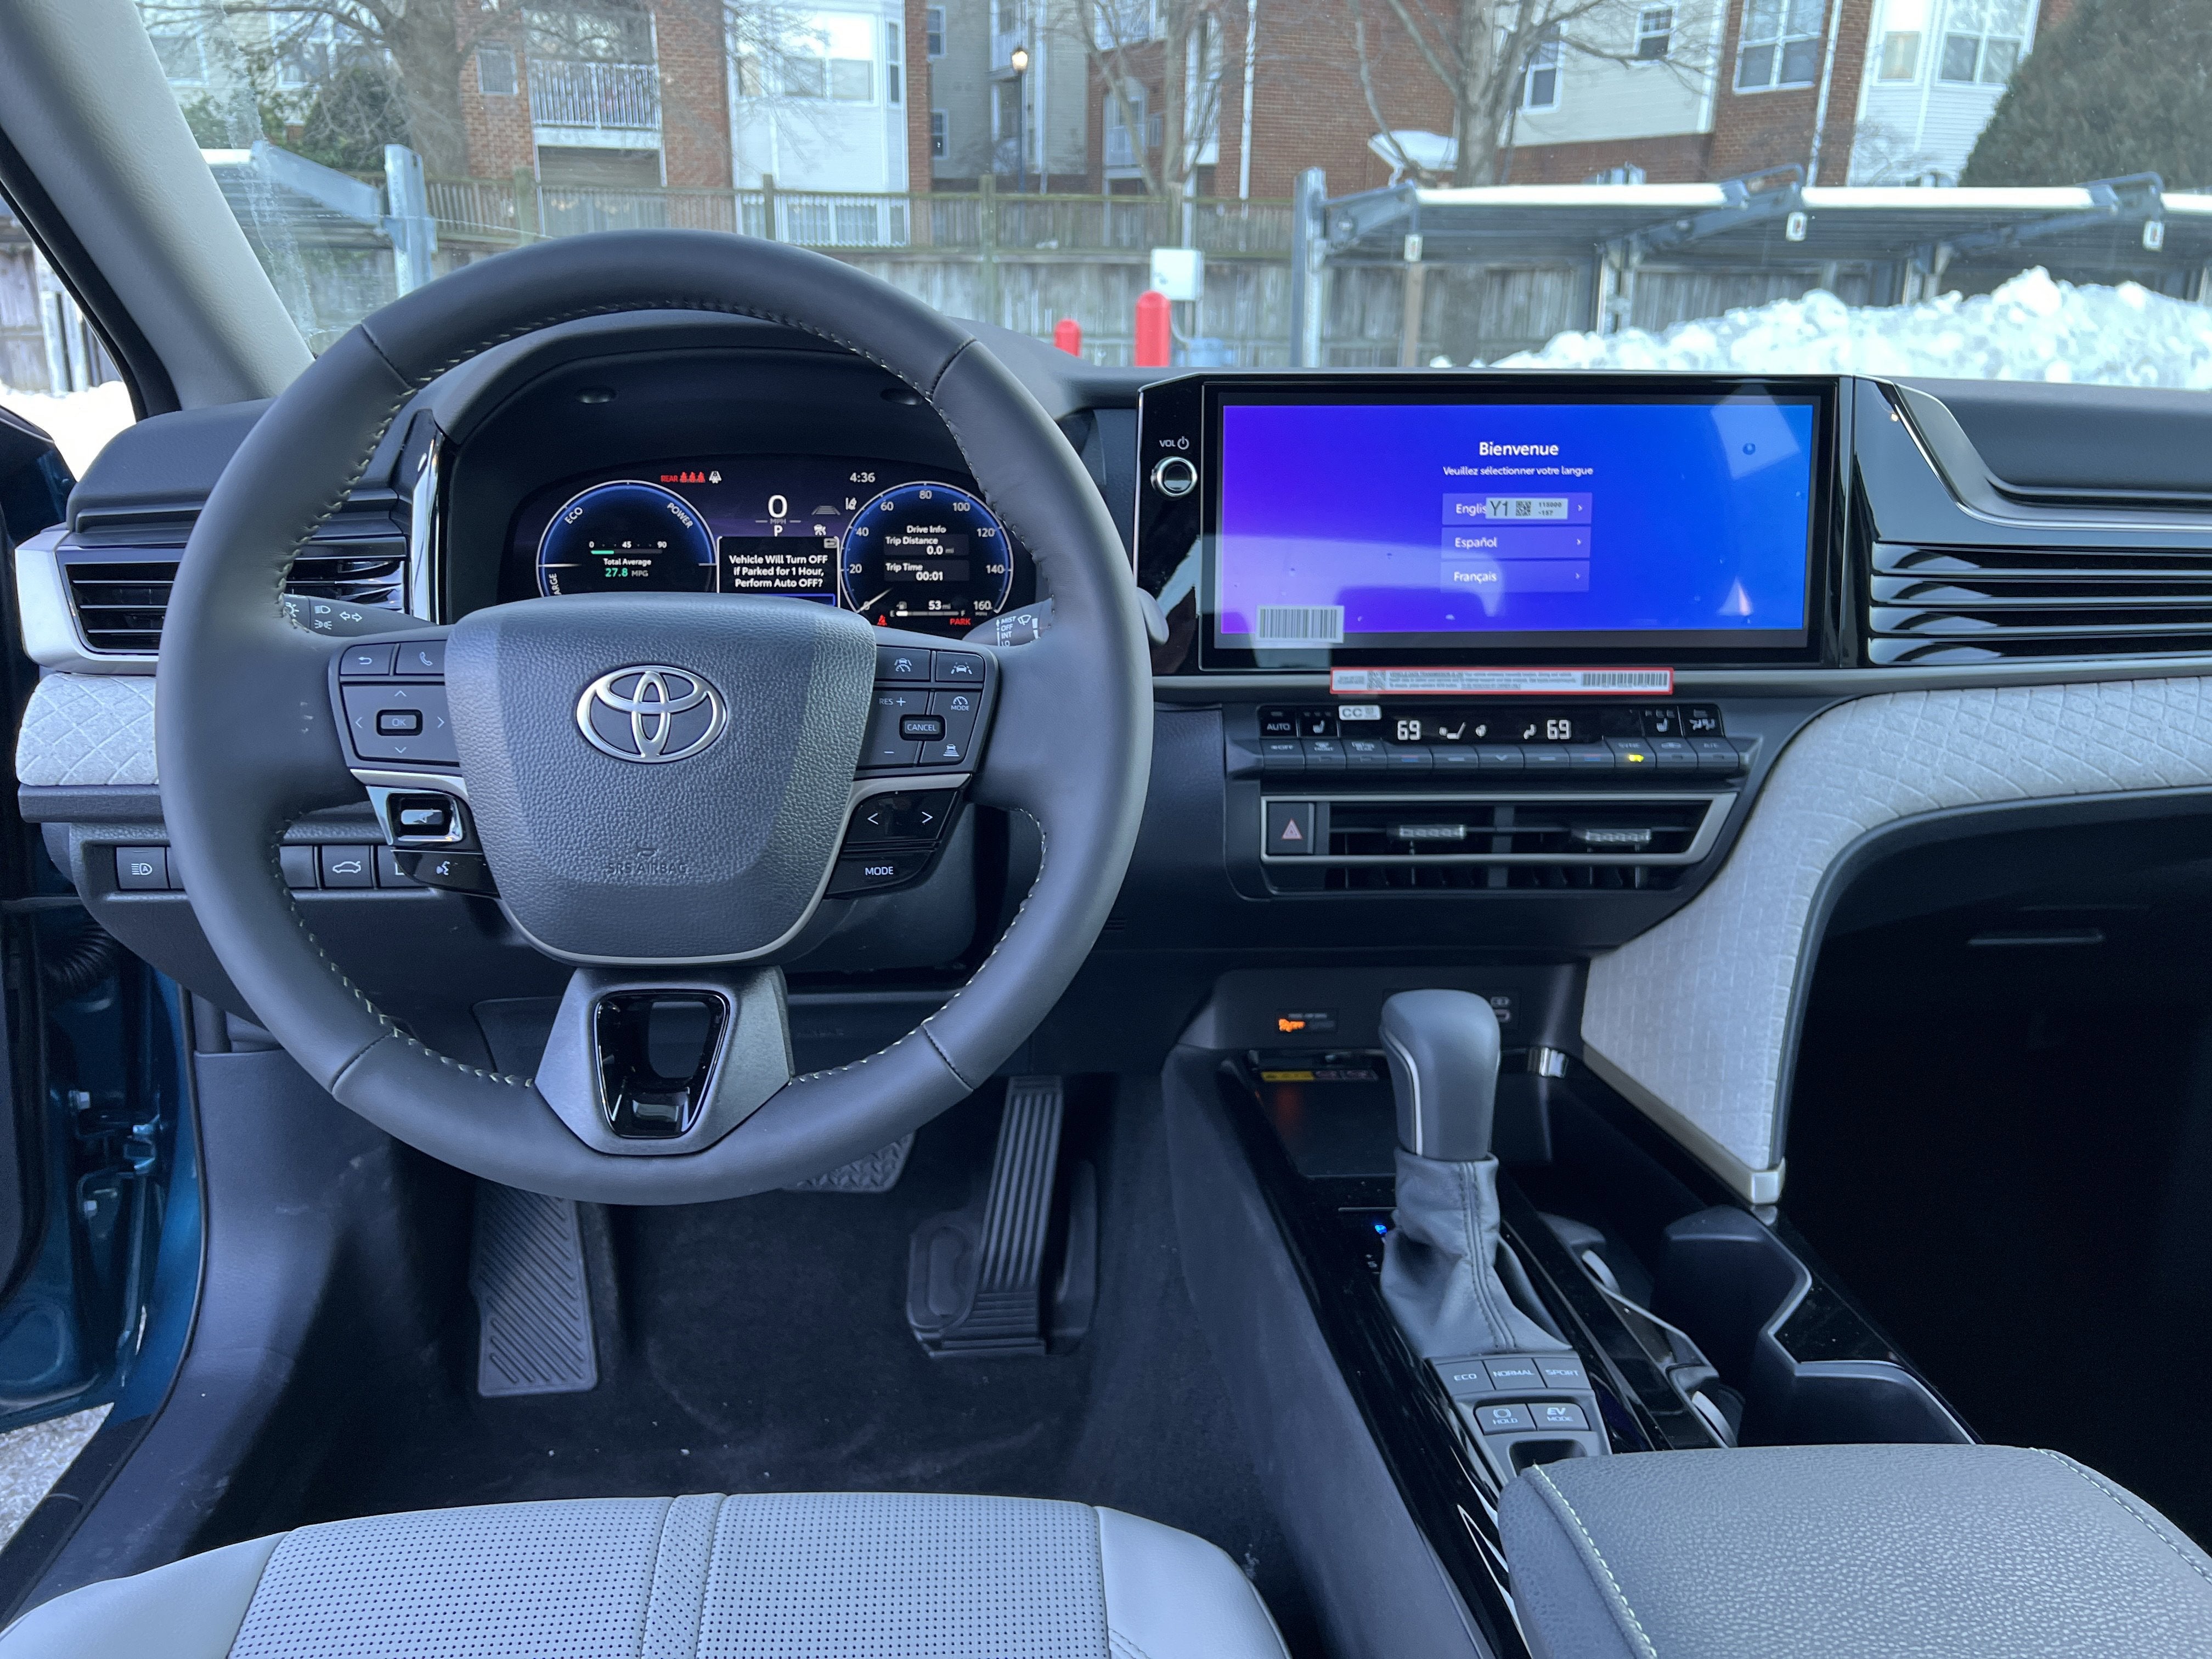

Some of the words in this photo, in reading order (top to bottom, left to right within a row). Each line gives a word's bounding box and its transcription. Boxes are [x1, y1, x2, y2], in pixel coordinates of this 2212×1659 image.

[1479, 441, 1559, 456] Bienvenue
[1443, 466, 1478, 476] Veuillez
[1480, 466, 1535, 475] sélectionner
[1536, 466, 1559, 475] votre
[1561, 465, 1593, 477] langue
[850, 472, 876, 483] 4:36
[919, 490, 932, 499] 80
[768, 494, 788, 518] 0
[881, 501, 894, 511] 60
[952, 502, 970, 511] 100
[1455, 504, 1487, 517] Englis
[1489, 500, 1508, 516] Y1
[564, 506, 583, 524] ECO
[667, 502, 693, 529] POWER
[774, 525, 783, 537] P
[856, 527, 869, 537] 40
[907, 525, 928, 533] Drive
[929, 525, 946, 533] Info
[977, 528, 995, 537] 120
[885, 537, 901, 546] Trip
[902, 537, 939, 545] Distance
[1454, 537, 1498, 550] Español
[927, 545, 944, 555] 0.0
[623, 558, 652, 567] Average
[729, 555, 764, 564] Vehicle
[765, 555, 785, 564] Will
[786, 555, 807, 564] Turn
[809, 555, 828, 564] OFF
[605, 568, 628, 577] 27.8
[742, 567, 774, 575] Parked
[776, 567, 790, 575] for
[792, 567, 796, 575] 1
[798, 567, 824, 577] Hour,
[850, 564, 862, 573] 20
[885, 563, 901, 572] Trip
[903, 563, 923, 571] Time
[986, 564, 1004, 573] 140
[916, 572, 943, 581] 00:01
[1453, 571, 1497, 584] Français
[549, 573, 562, 595] ARGE
[735, 579, 772, 588] Perform
[774, 579, 797, 588] Auto
[799, 579, 823, 588] OFF?
[928, 600, 941, 610] 53
[973, 600, 991, 610] 160
[1001, 616, 1017, 624] MIST
[1001, 631, 1012, 639] INT
[1342, 708, 1362, 718] CC
[392, 718, 407, 727] OK
[1267, 723, 1291, 731] AUTO
[907, 724, 937, 732] CANCEL
[1397, 720, 1423, 740] 69
[1547, 719, 1572, 740] 69
[608, 862, 630, 874] SRS
[636, 862, 688, 874] AIRBAG
[865, 867, 894, 876] MODE
[1493, 1369, 1534, 1378] NORMAL
[1547, 1407, 1566, 1415] EV
